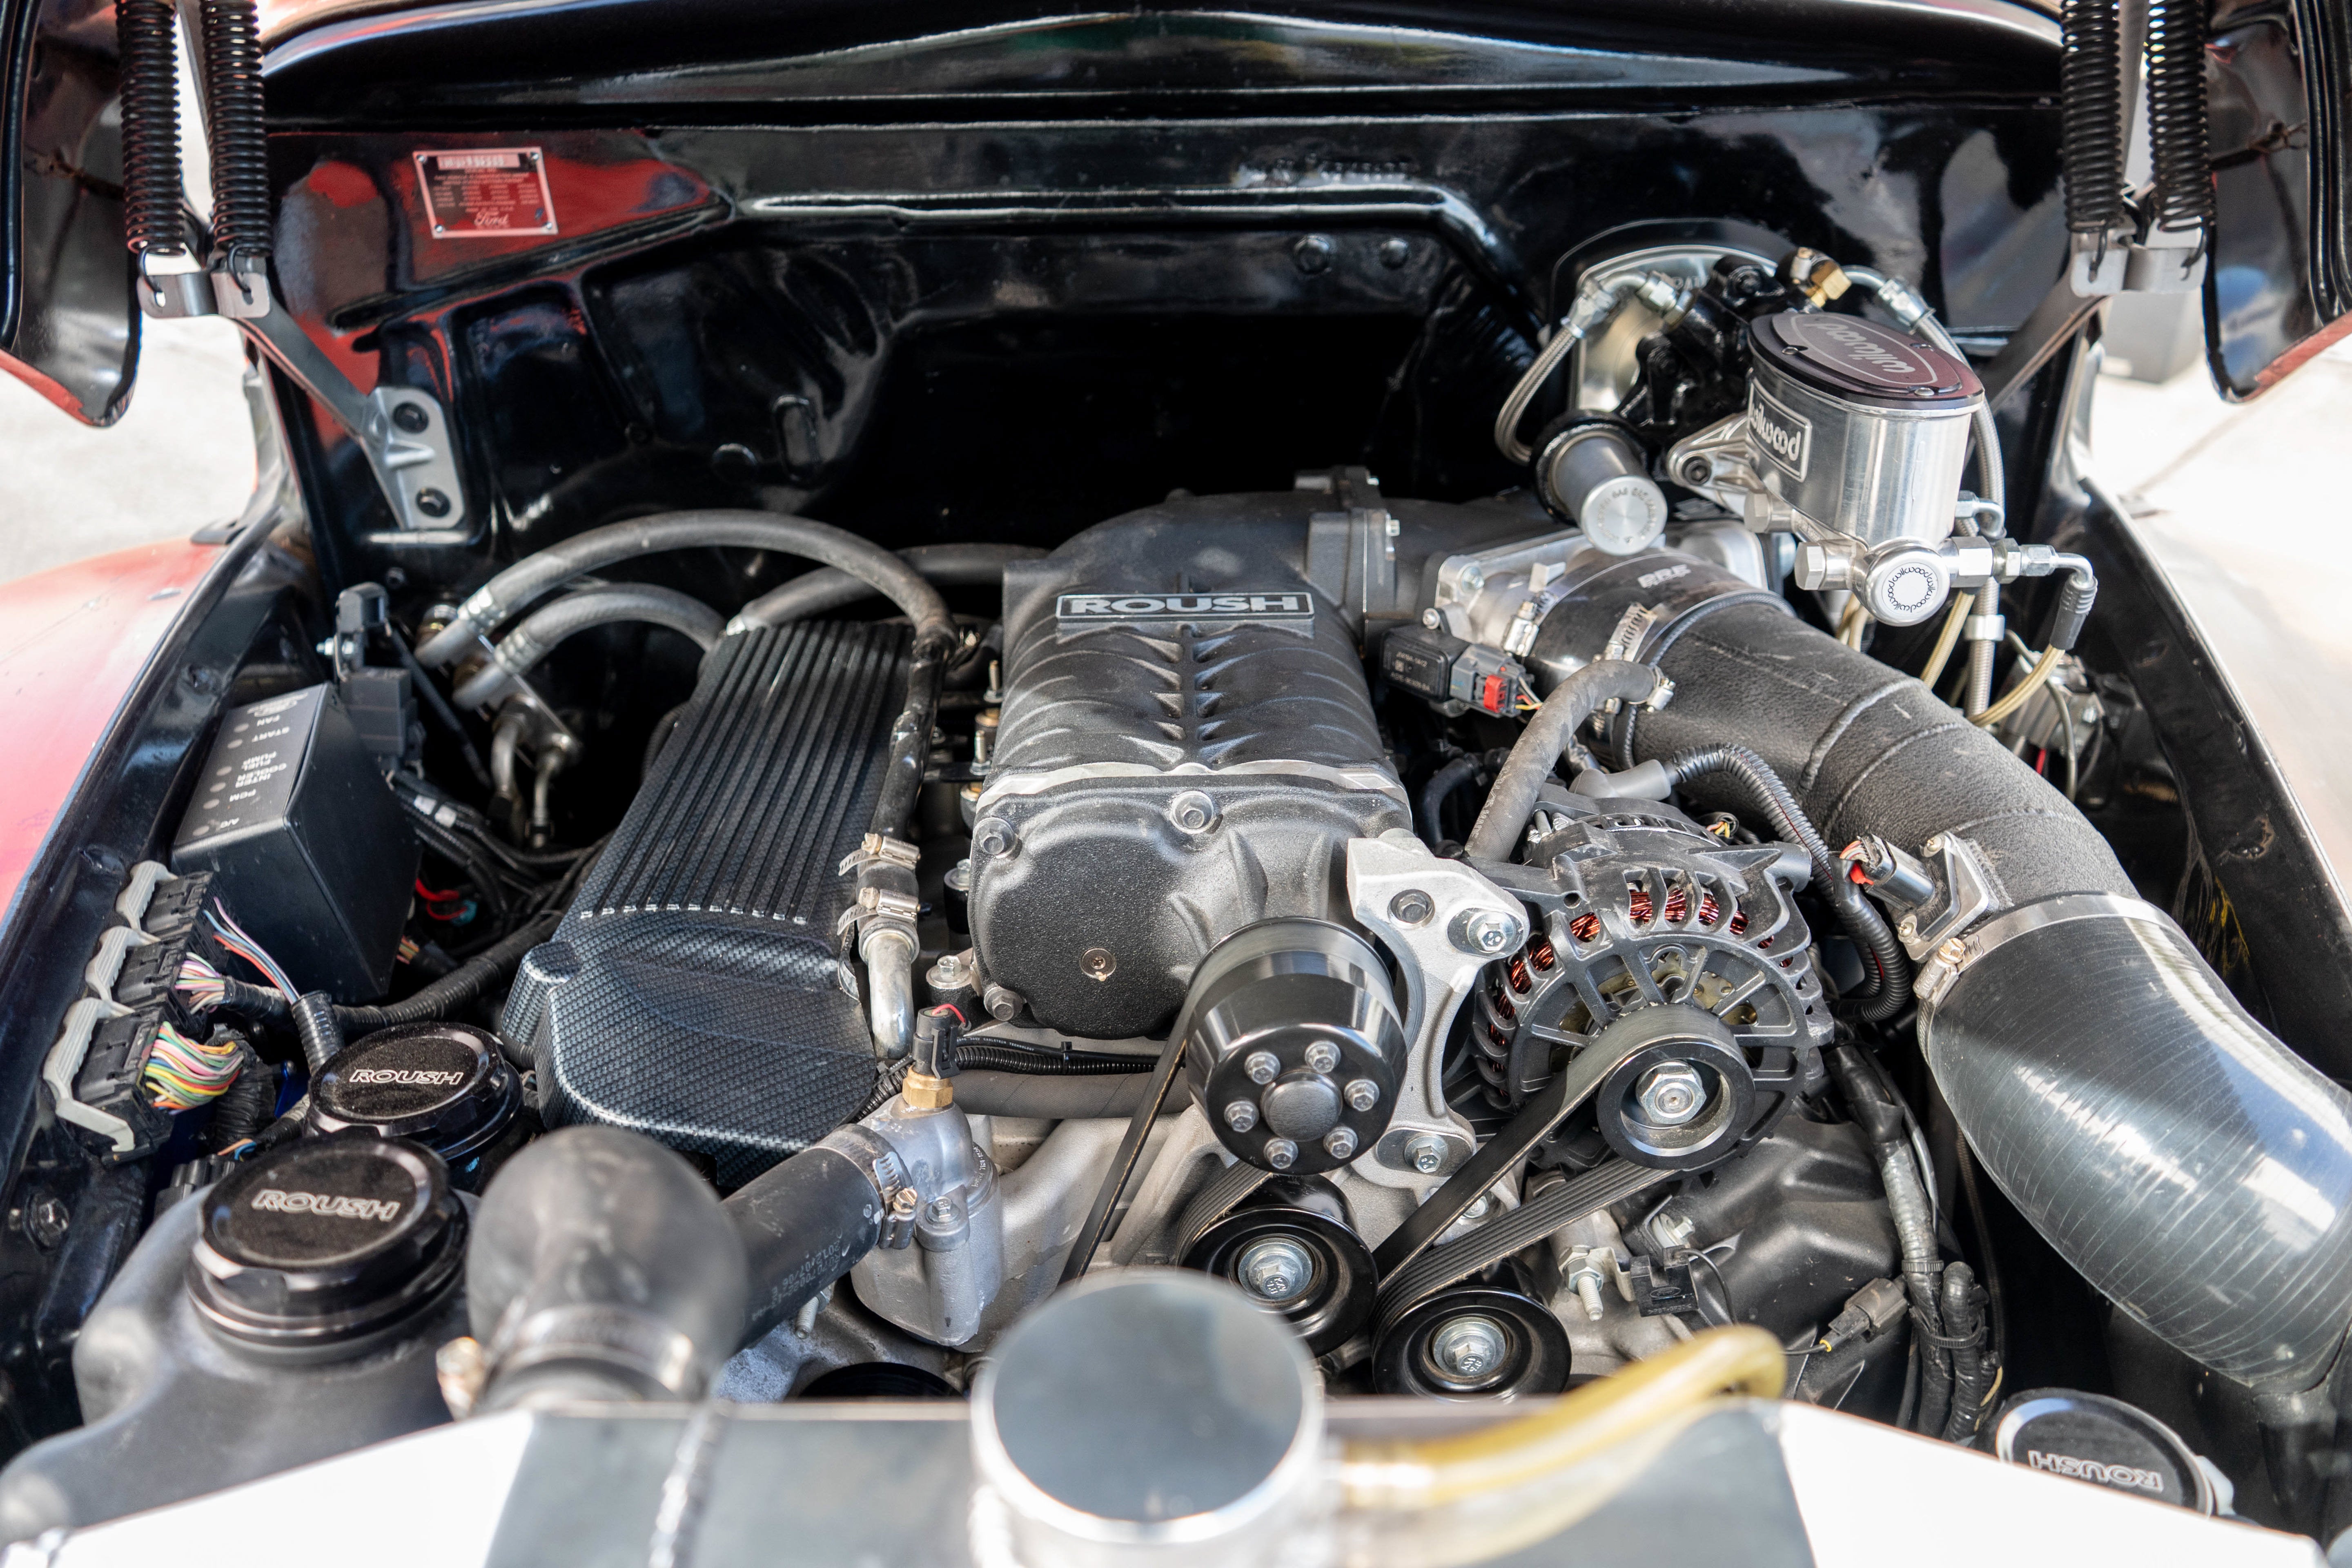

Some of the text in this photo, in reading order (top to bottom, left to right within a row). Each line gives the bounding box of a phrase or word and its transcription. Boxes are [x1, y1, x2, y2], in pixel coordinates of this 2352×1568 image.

[1803, 323, 1915, 373] wilwood
[1893, 567, 1933, 582] wilwood
[1070, 595, 1299, 615] ROUSH
[1888, 580, 1911, 612] wilwood
[1910, 577, 1936, 613] wilwood
[257, 715, 281, 726] FAN
[251, 726, 290, 742] START
[1009, 1042, 1035, 1051] TECHNOLOGY
[350, 1069, 464, 1085] ROUSH
[251, 1189, 401, 1222] ROUSH
[2028, 1450, 2164, 1494] ROUSH
